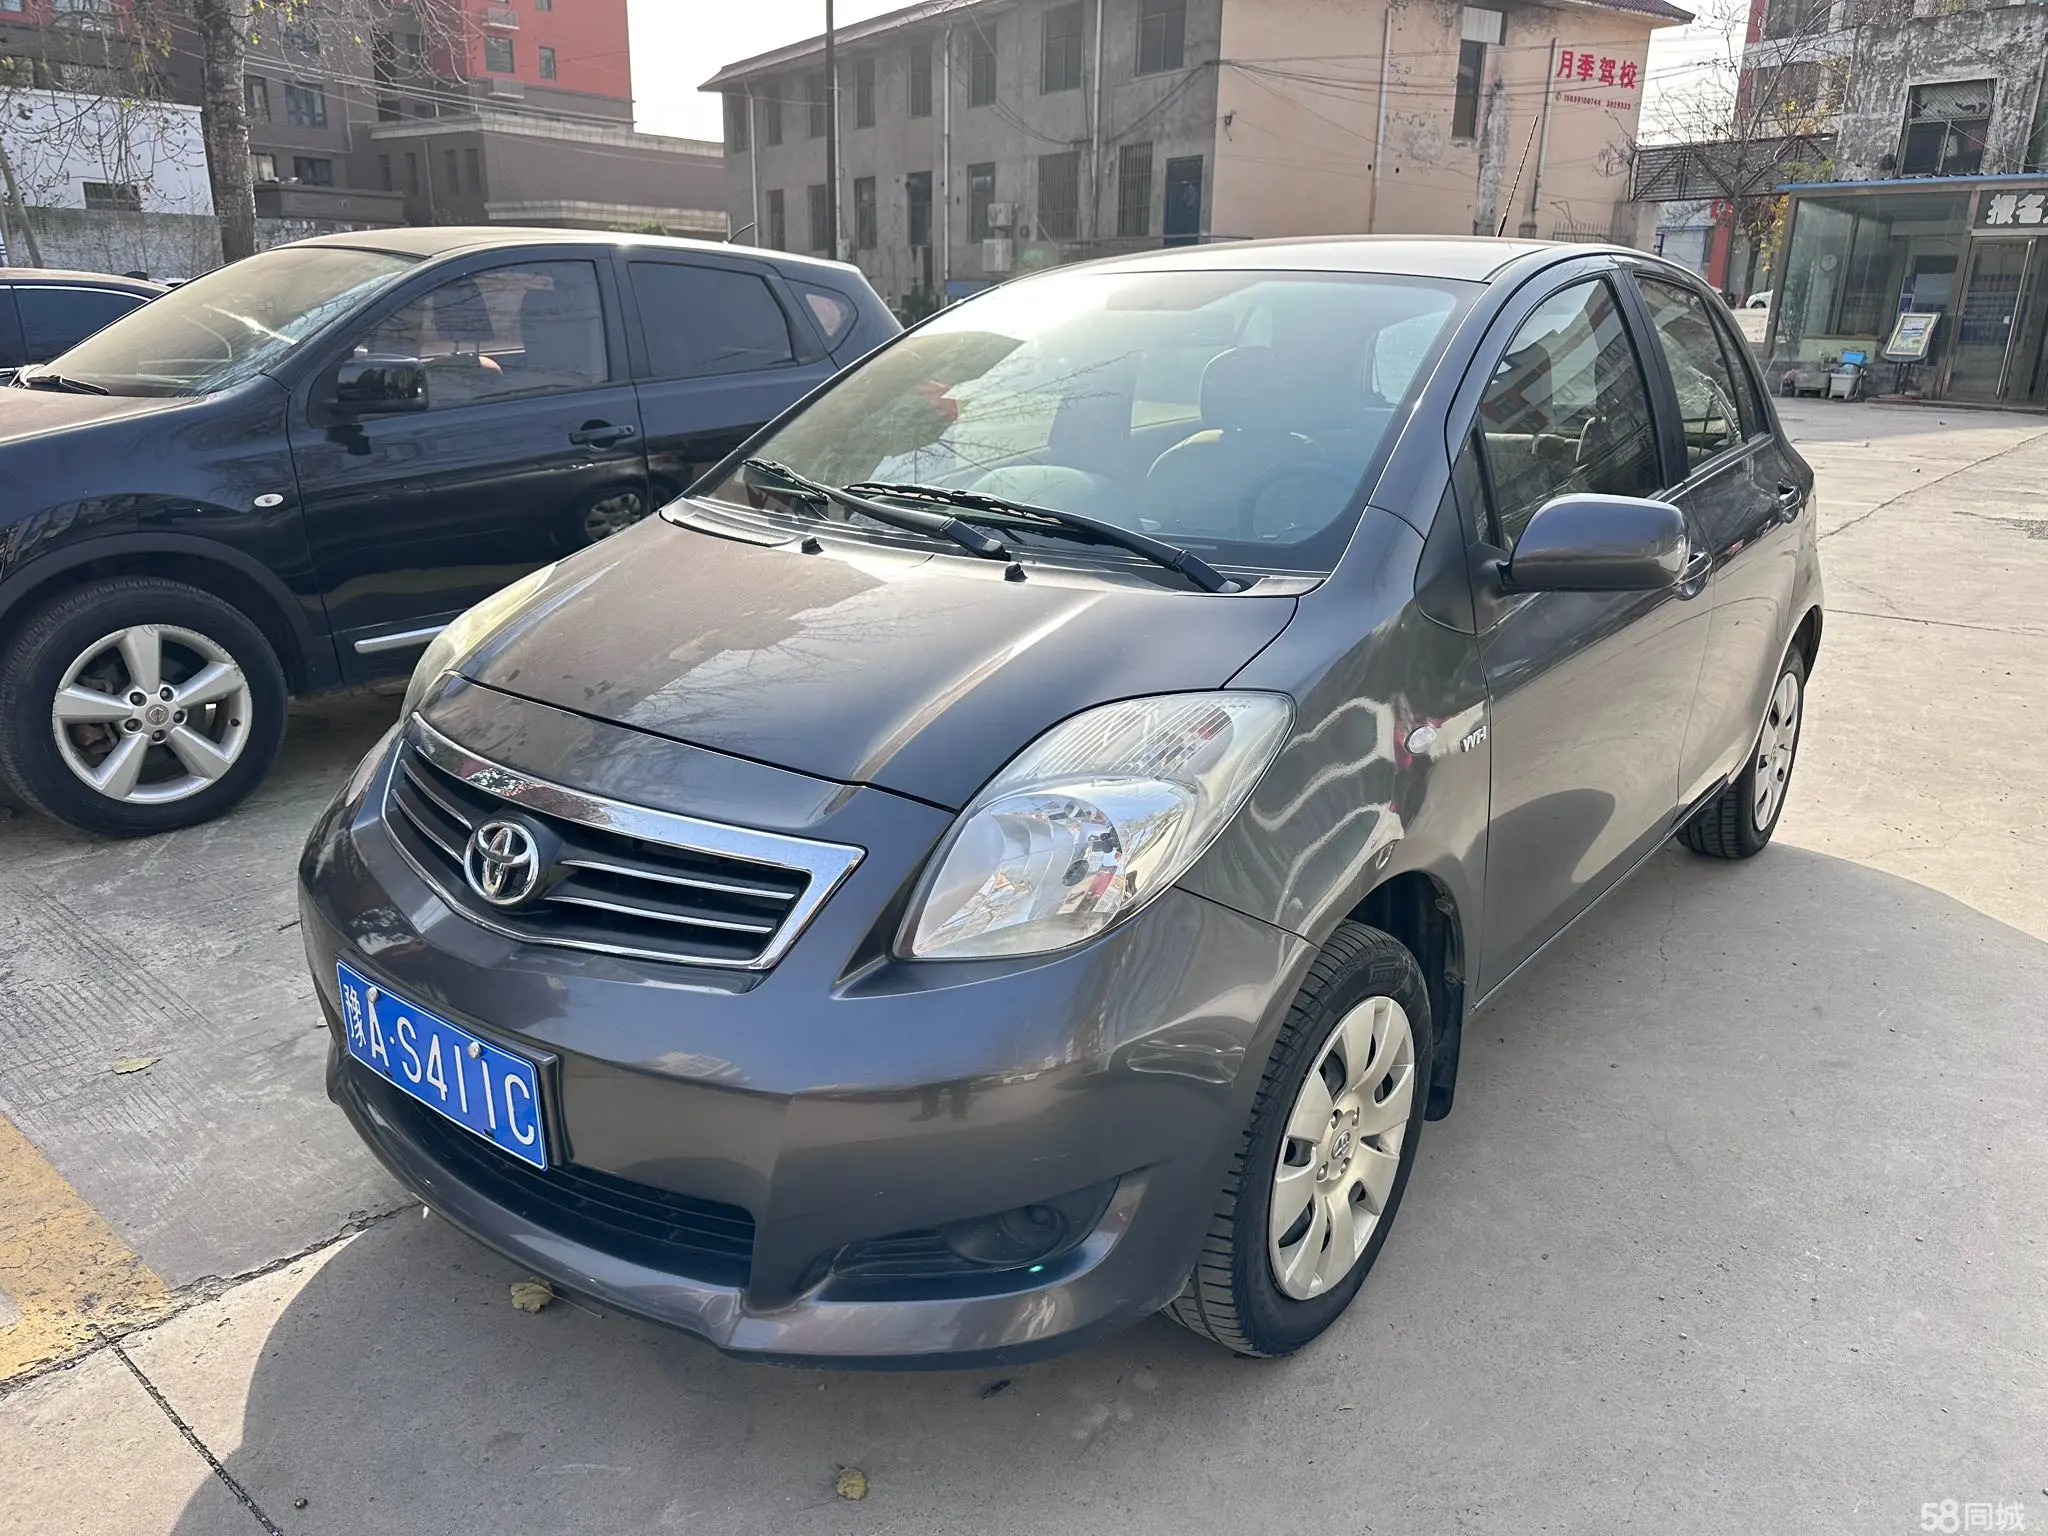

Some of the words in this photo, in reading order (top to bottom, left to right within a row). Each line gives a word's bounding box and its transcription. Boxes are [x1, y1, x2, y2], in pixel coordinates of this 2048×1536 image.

[1556, 50, 1638, 89] 月季驾校
[1985, 193, 2048, 225] 报名
